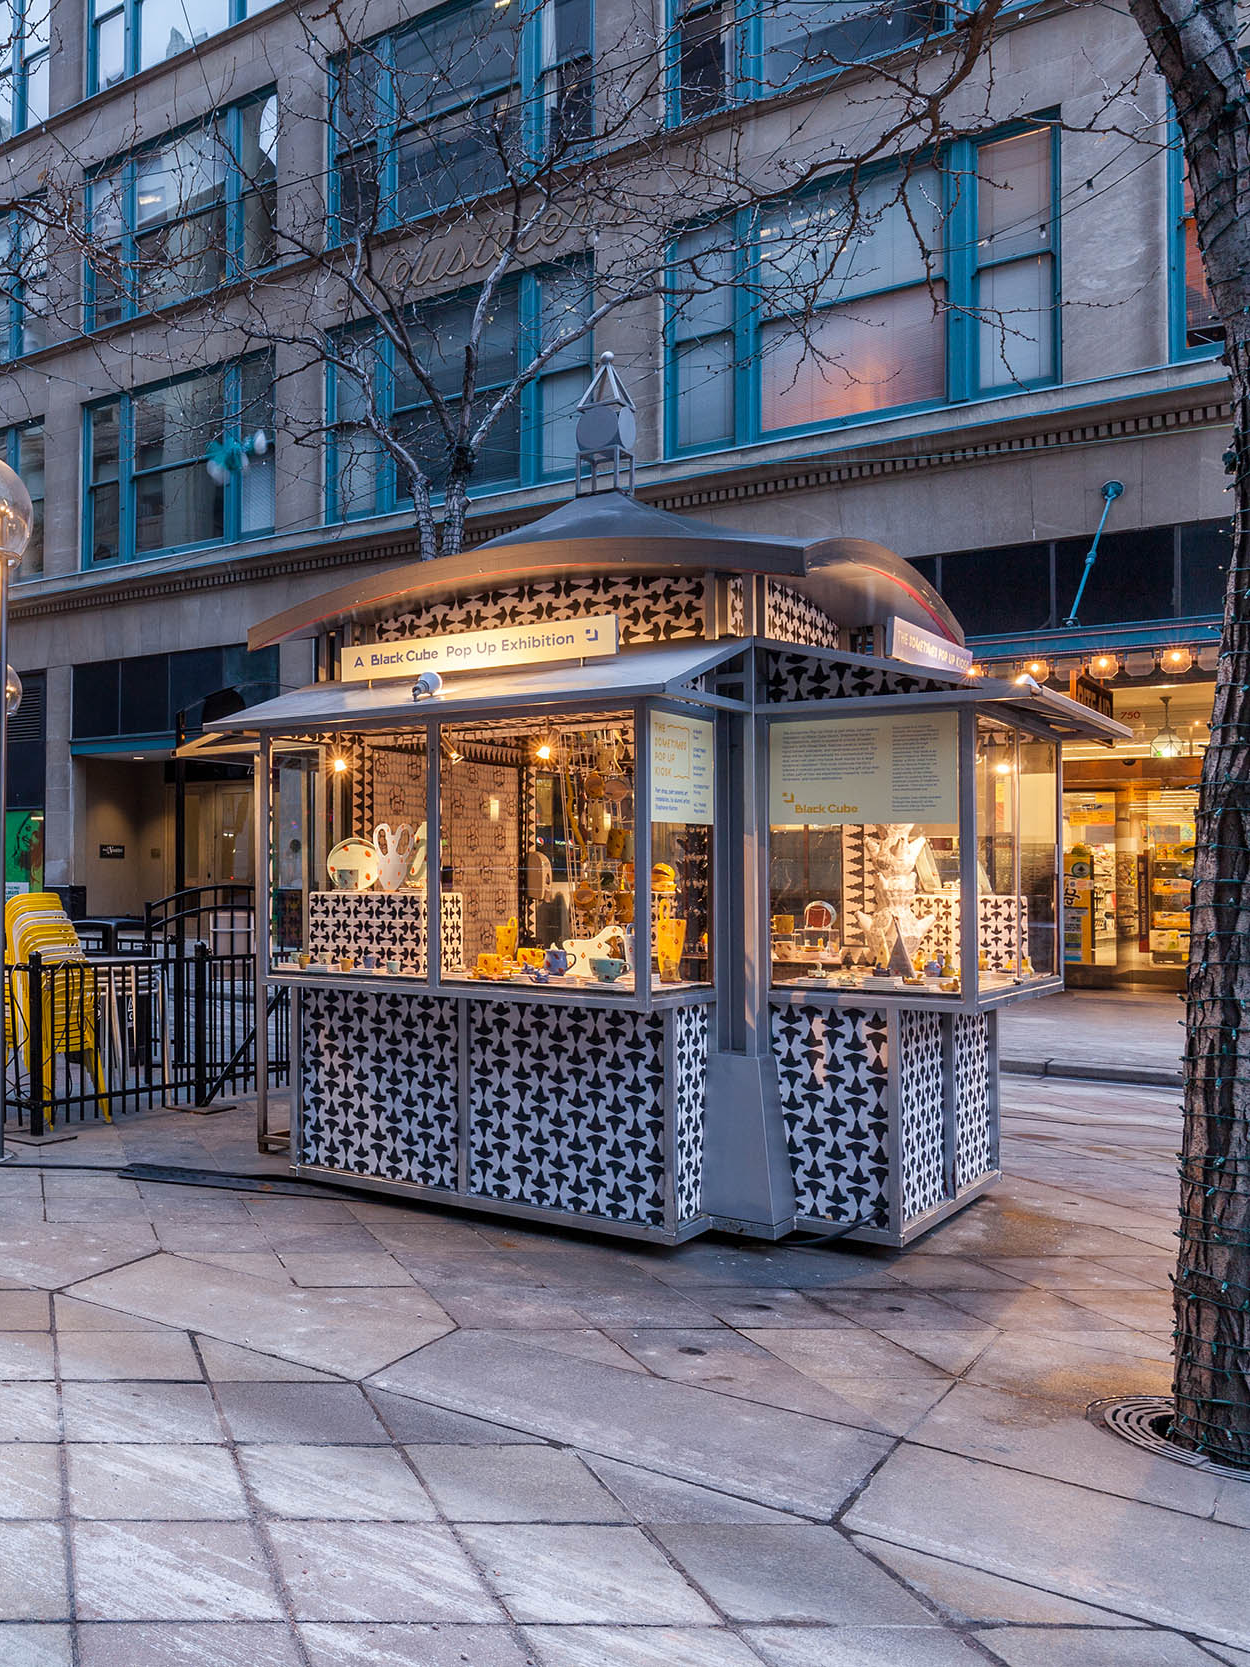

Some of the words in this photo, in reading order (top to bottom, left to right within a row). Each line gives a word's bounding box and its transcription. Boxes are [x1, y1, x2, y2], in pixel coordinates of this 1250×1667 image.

[897, 630, 909, 645] THE
[354, 656, 364, 668] A
[370, 652, 403, 666] Black
[406, 648, 439, 662] Cube
[446, 645, 472, 659] Pop
[476, 641, 497, 656] Up
[501, 633, 575, 651] Exhibition
[1120, 711, 1141, 720] 750
[654, 722, 666, 733] THE
[654, 752, 666, 761] POP
[795, 804, 824, 814] Black
[828, 804, 858, 813] Cube
